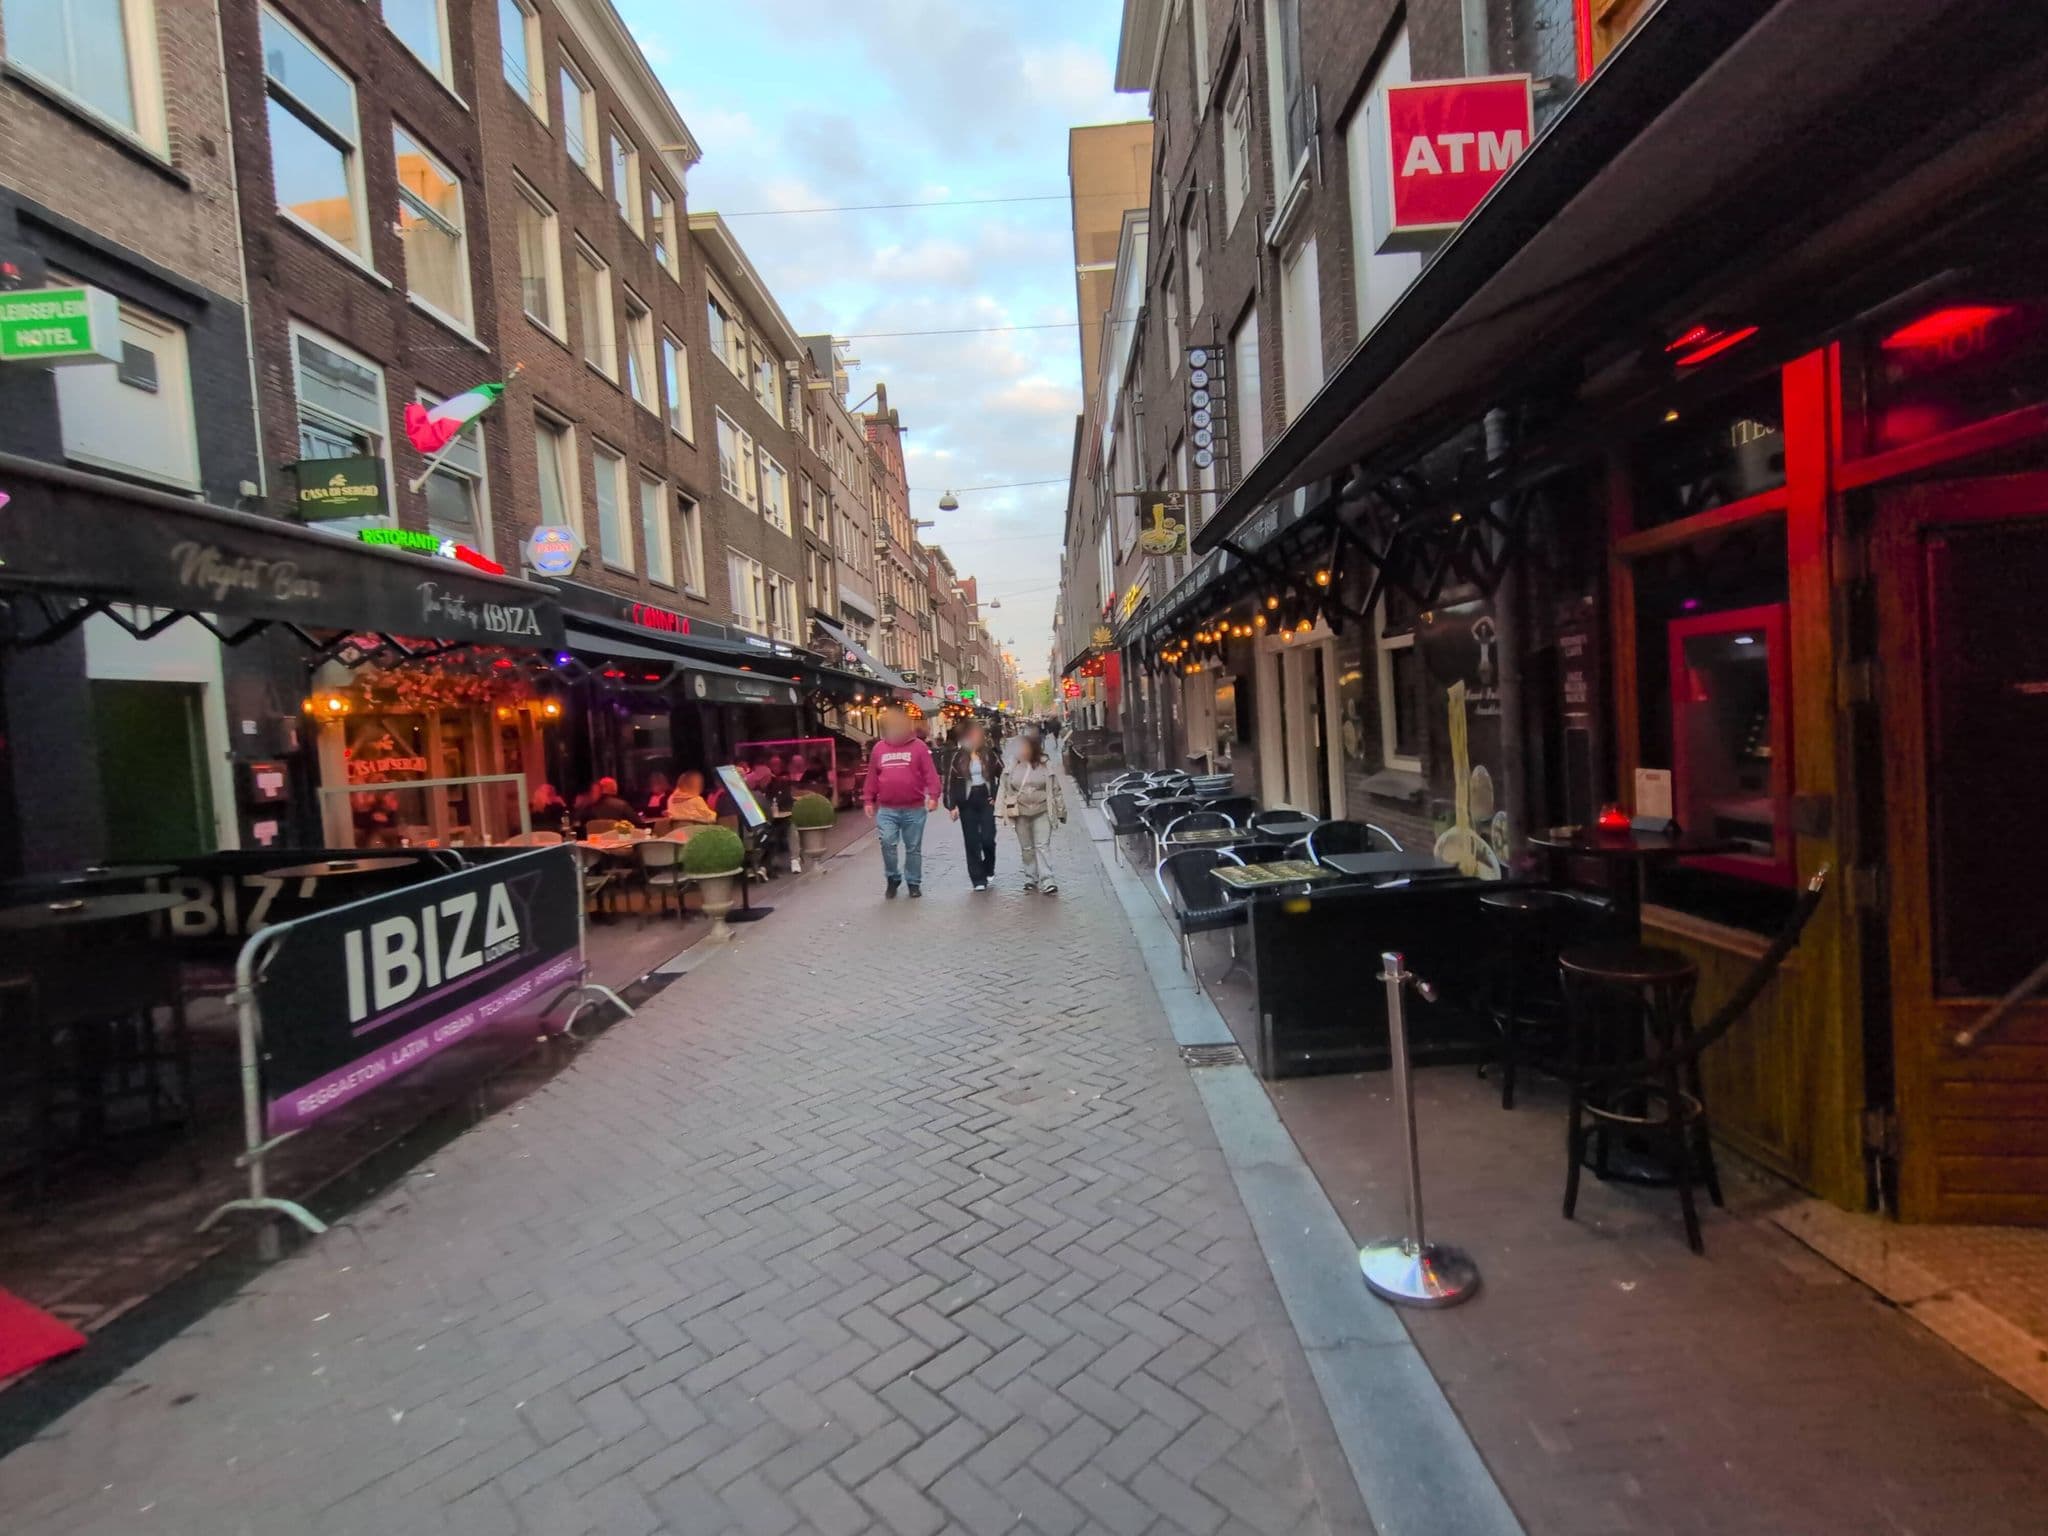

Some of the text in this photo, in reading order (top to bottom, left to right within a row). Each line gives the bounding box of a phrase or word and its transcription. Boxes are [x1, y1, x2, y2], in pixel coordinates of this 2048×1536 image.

[1401, 129, 1523, 177] ATM
[16, 328, 78, 347] HOTEL
[301, 488, 328, 501] CASA
[342, 485, 378, 497] SERGIO
[362, 528, 439, 552] RISTORANTE
[483, 603, 542, 635] IBIZA
[345, 882, 520, 1023] IBIZA
[485, 935, 520, 962] LOUNGE
[296, 1059, 386, 1115] REGGAETON
[392, 1037, 429, 1065] LATIN
[433, 1013, 474, 1042] URBAN
